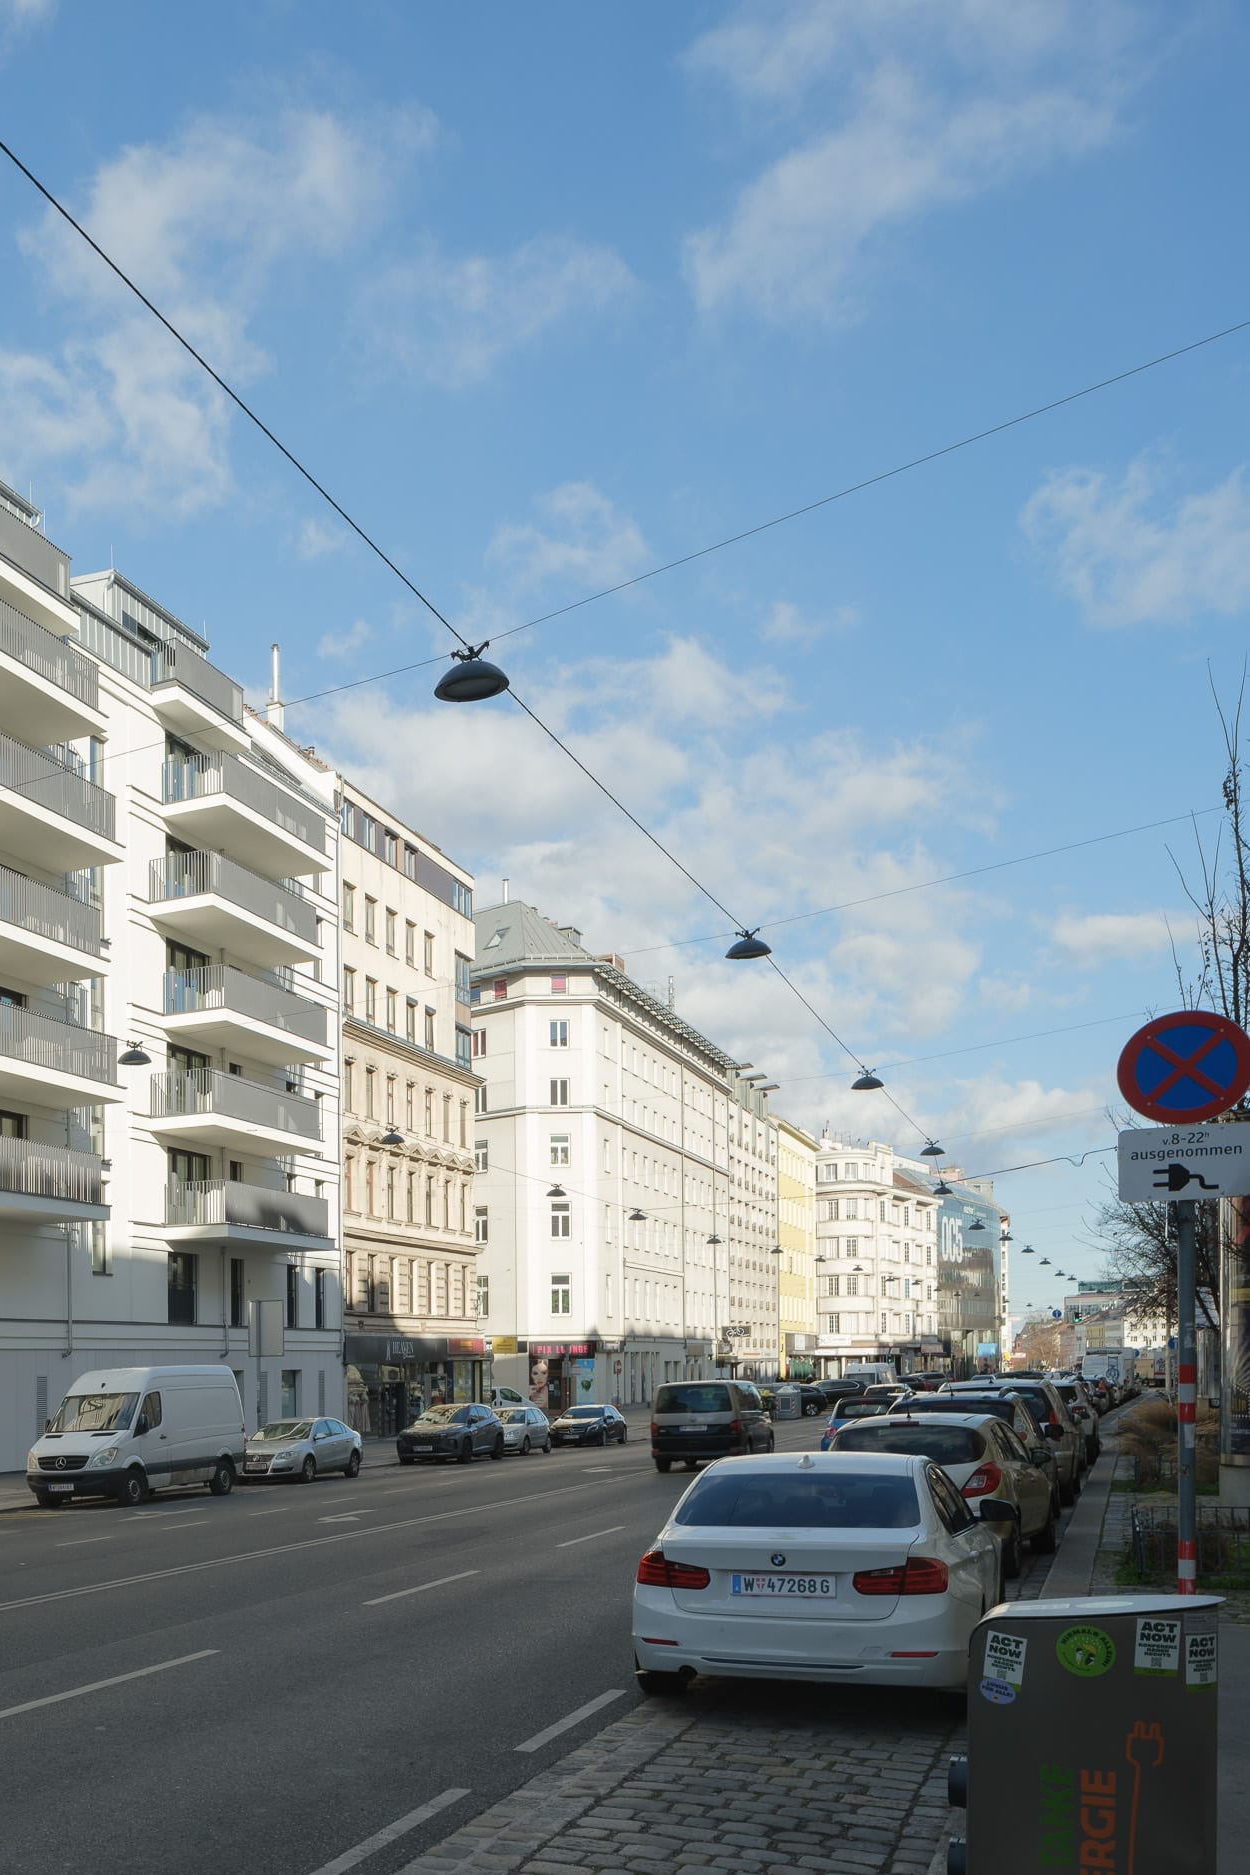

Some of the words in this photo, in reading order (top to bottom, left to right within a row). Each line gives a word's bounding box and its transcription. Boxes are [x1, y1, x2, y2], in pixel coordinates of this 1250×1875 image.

[1130, 1144, 1243, 1162] ausgenommen
[743, 1577, 755, 1592] W
[767, 1578, 817, 1593] 47268
[1141, 1621, 1178, 1633] ACT
[990, 1634, 1024, 1649] ACT
[1140, 1632, 1177, 1643] NOW
[1190, 1636, 1215, 1648] ACT
[989, 1644, 1022, 1659] NOW
[1189, 1648, 1215, 1658] NOW
